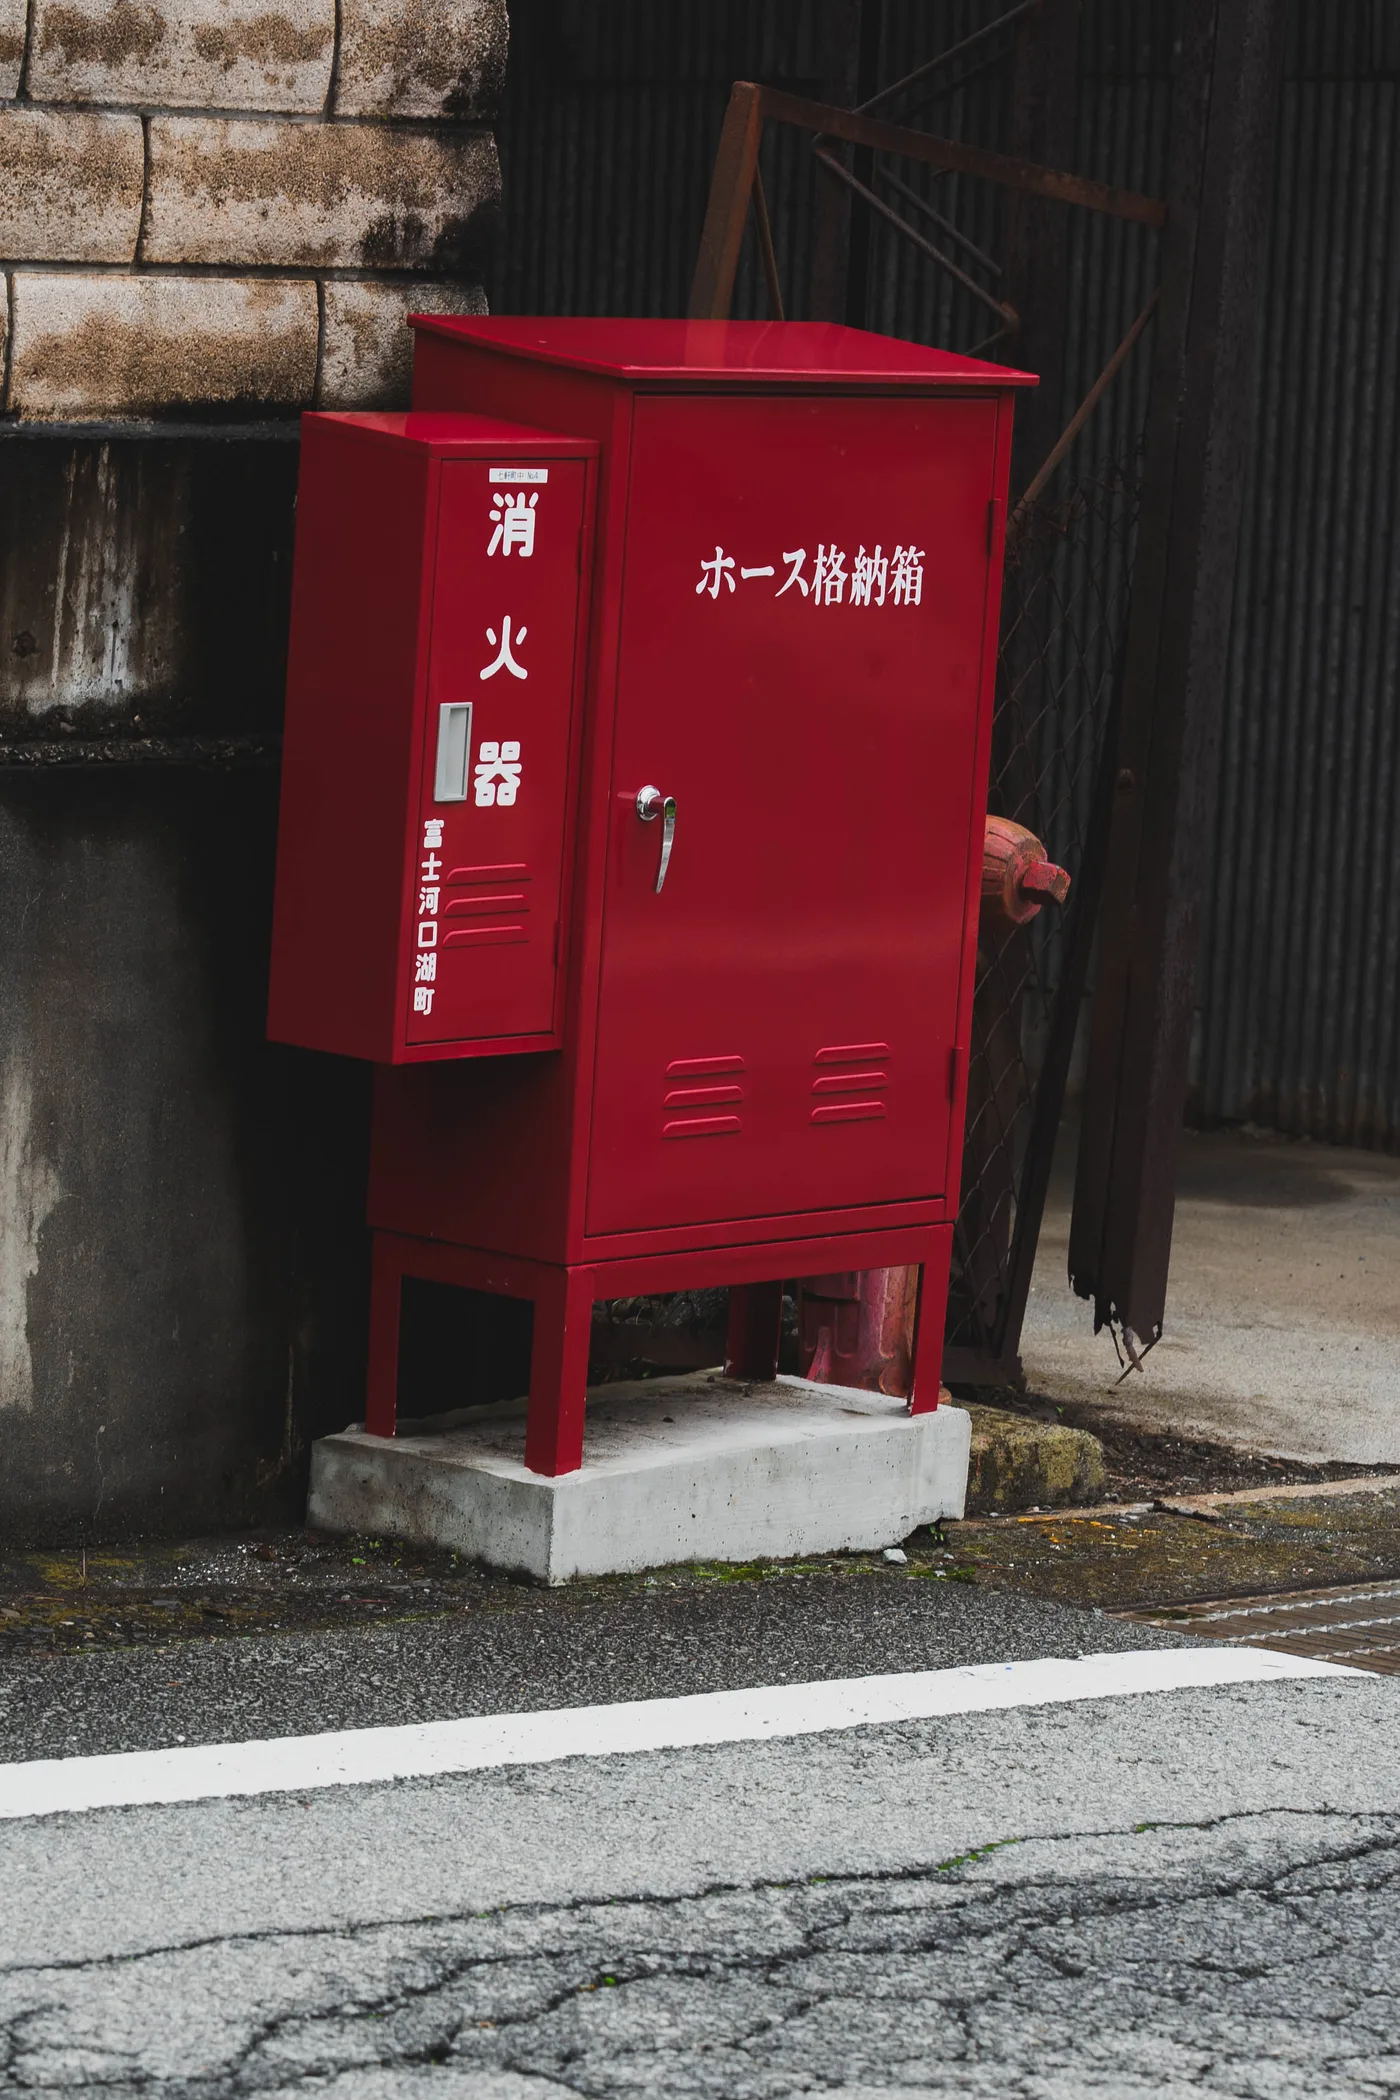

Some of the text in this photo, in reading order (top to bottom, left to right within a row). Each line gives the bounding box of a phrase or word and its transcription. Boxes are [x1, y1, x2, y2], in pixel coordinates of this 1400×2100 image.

[474, 492, 539, 807] 消火器
[696, 544, 926, 606] ホース格納箱
[414, 819, 445, 1015] 富士河口湖町
